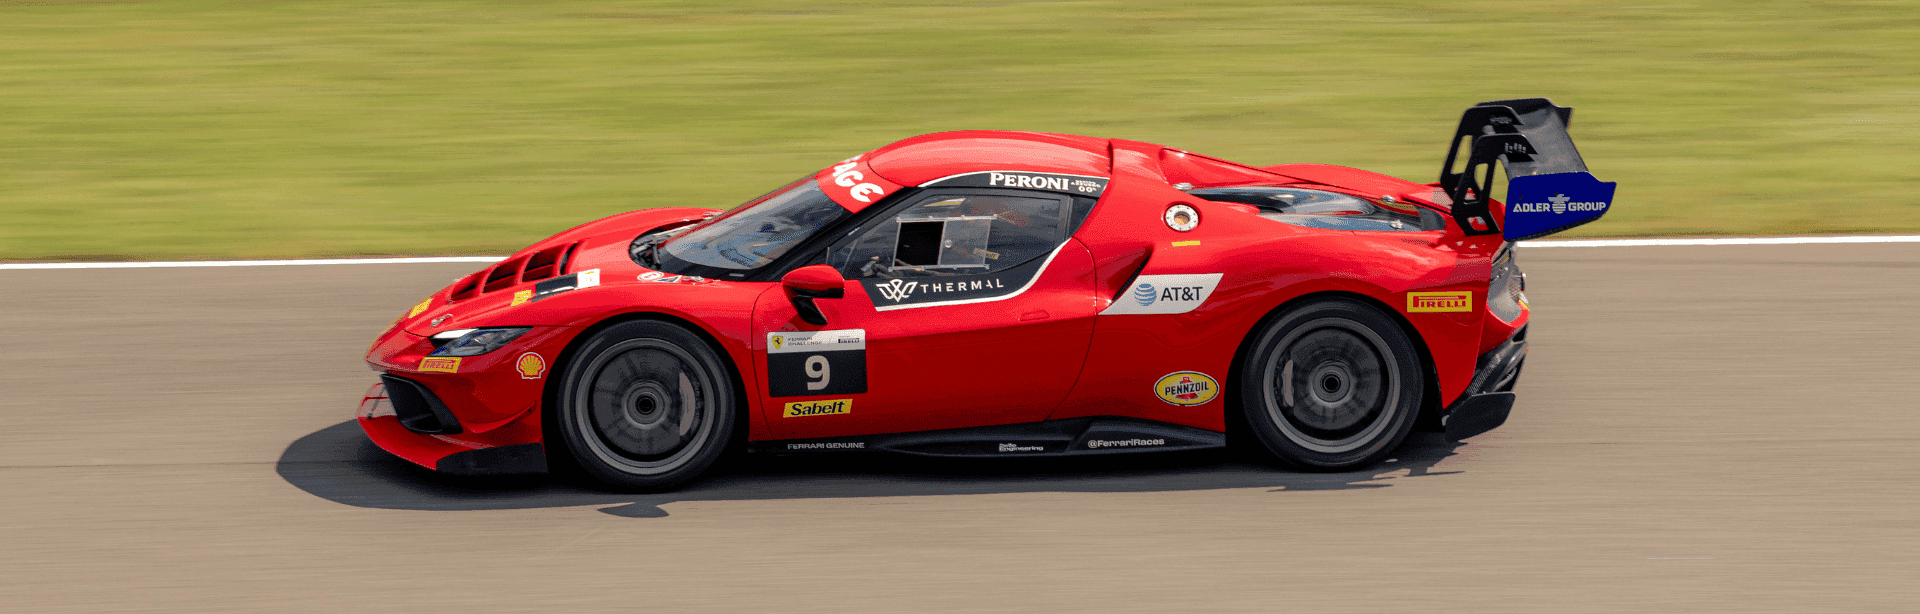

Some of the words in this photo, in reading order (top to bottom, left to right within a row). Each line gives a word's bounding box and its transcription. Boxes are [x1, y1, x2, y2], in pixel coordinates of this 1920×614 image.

[989, 172, 1069, 191] PERONI
[1513, 202, 1551, 213] ADLER
[1568, 201, 1607, 212] GROUP
[920, 278, 1004, 294] THERMAL
[1161, 286, 1204, 302] AT&T
[1413, 295, 1467, 308] PIRELLI
[422, 359, 457, 370] PIRELLI
[804, 355, 831, 391] 9
[1164, 381, 1210, 397] PENNZOIL
[790, 401, 845, 416] Sabelt
[1087, 439, 1165, 449] @FerrariRaces
